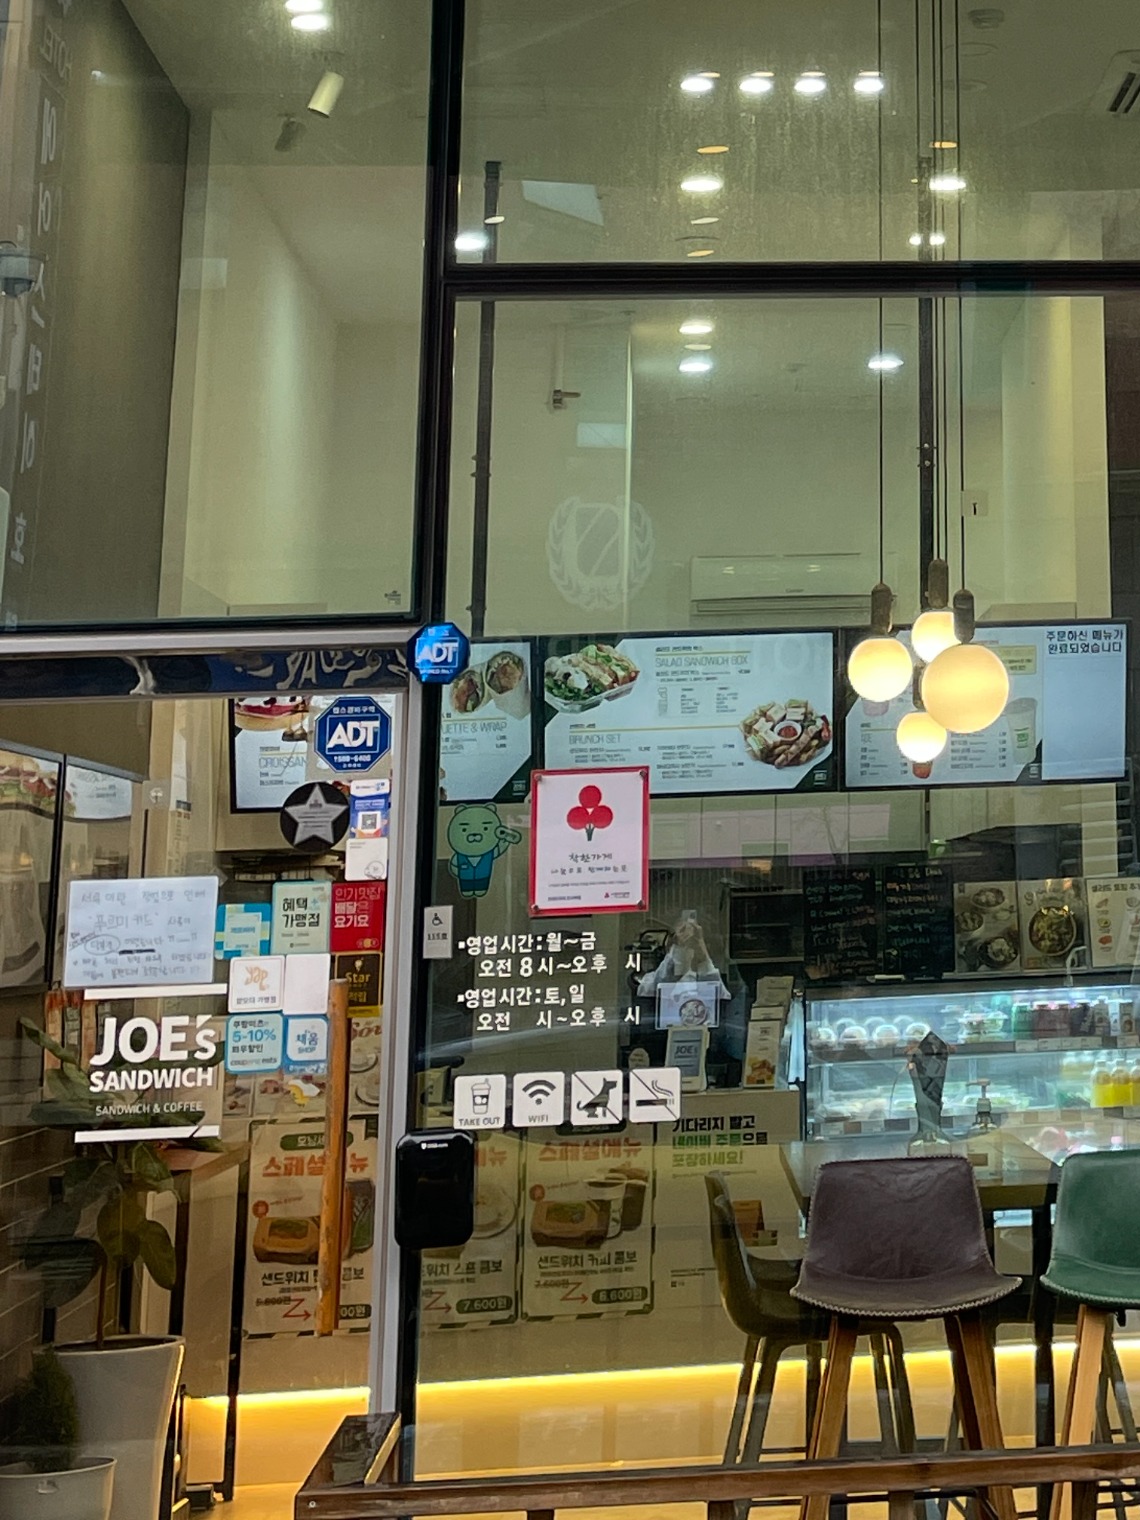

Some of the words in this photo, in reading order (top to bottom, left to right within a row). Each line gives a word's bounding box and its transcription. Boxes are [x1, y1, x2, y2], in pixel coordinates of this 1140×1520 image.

[416, 642, 459, 664] ADT
[326, 719, 381, 749] ADT
[258, 756, 308, 769] CROISSAN
[335, 887, 381, 902] 인기맛집
[281, 896, 309, 912] 혜택
[281, 913, 321, 929] 가맹점
[334, 914, 370, 929] 요기요
[477, 958, 513, 978] 오전
[624, 953, 642, 972] 시
[475, 1011, 511, 1032] 오전
[623, 1005, 641, 1026] 시
[89, 1013, 217, 1066] JOE's
[89, 1066, 213, 1093] SANDWICH
[95, 1104, 151, 1116] SANDWICH
[153, 1103, 160, 1114] &
[163, 1101, 203, 1113] COFFEE
[458, 1116, 480, 1128] TAKE
[482, 1115, 502, 1127] OUT
[527, 1113, 550, 1125] WIFI
[672, 1115, 725, 1133] 기다리지
[537, 1254, 585, 1270] 샌드위치
[260, 1269, 309, 1286] 샌드위치
